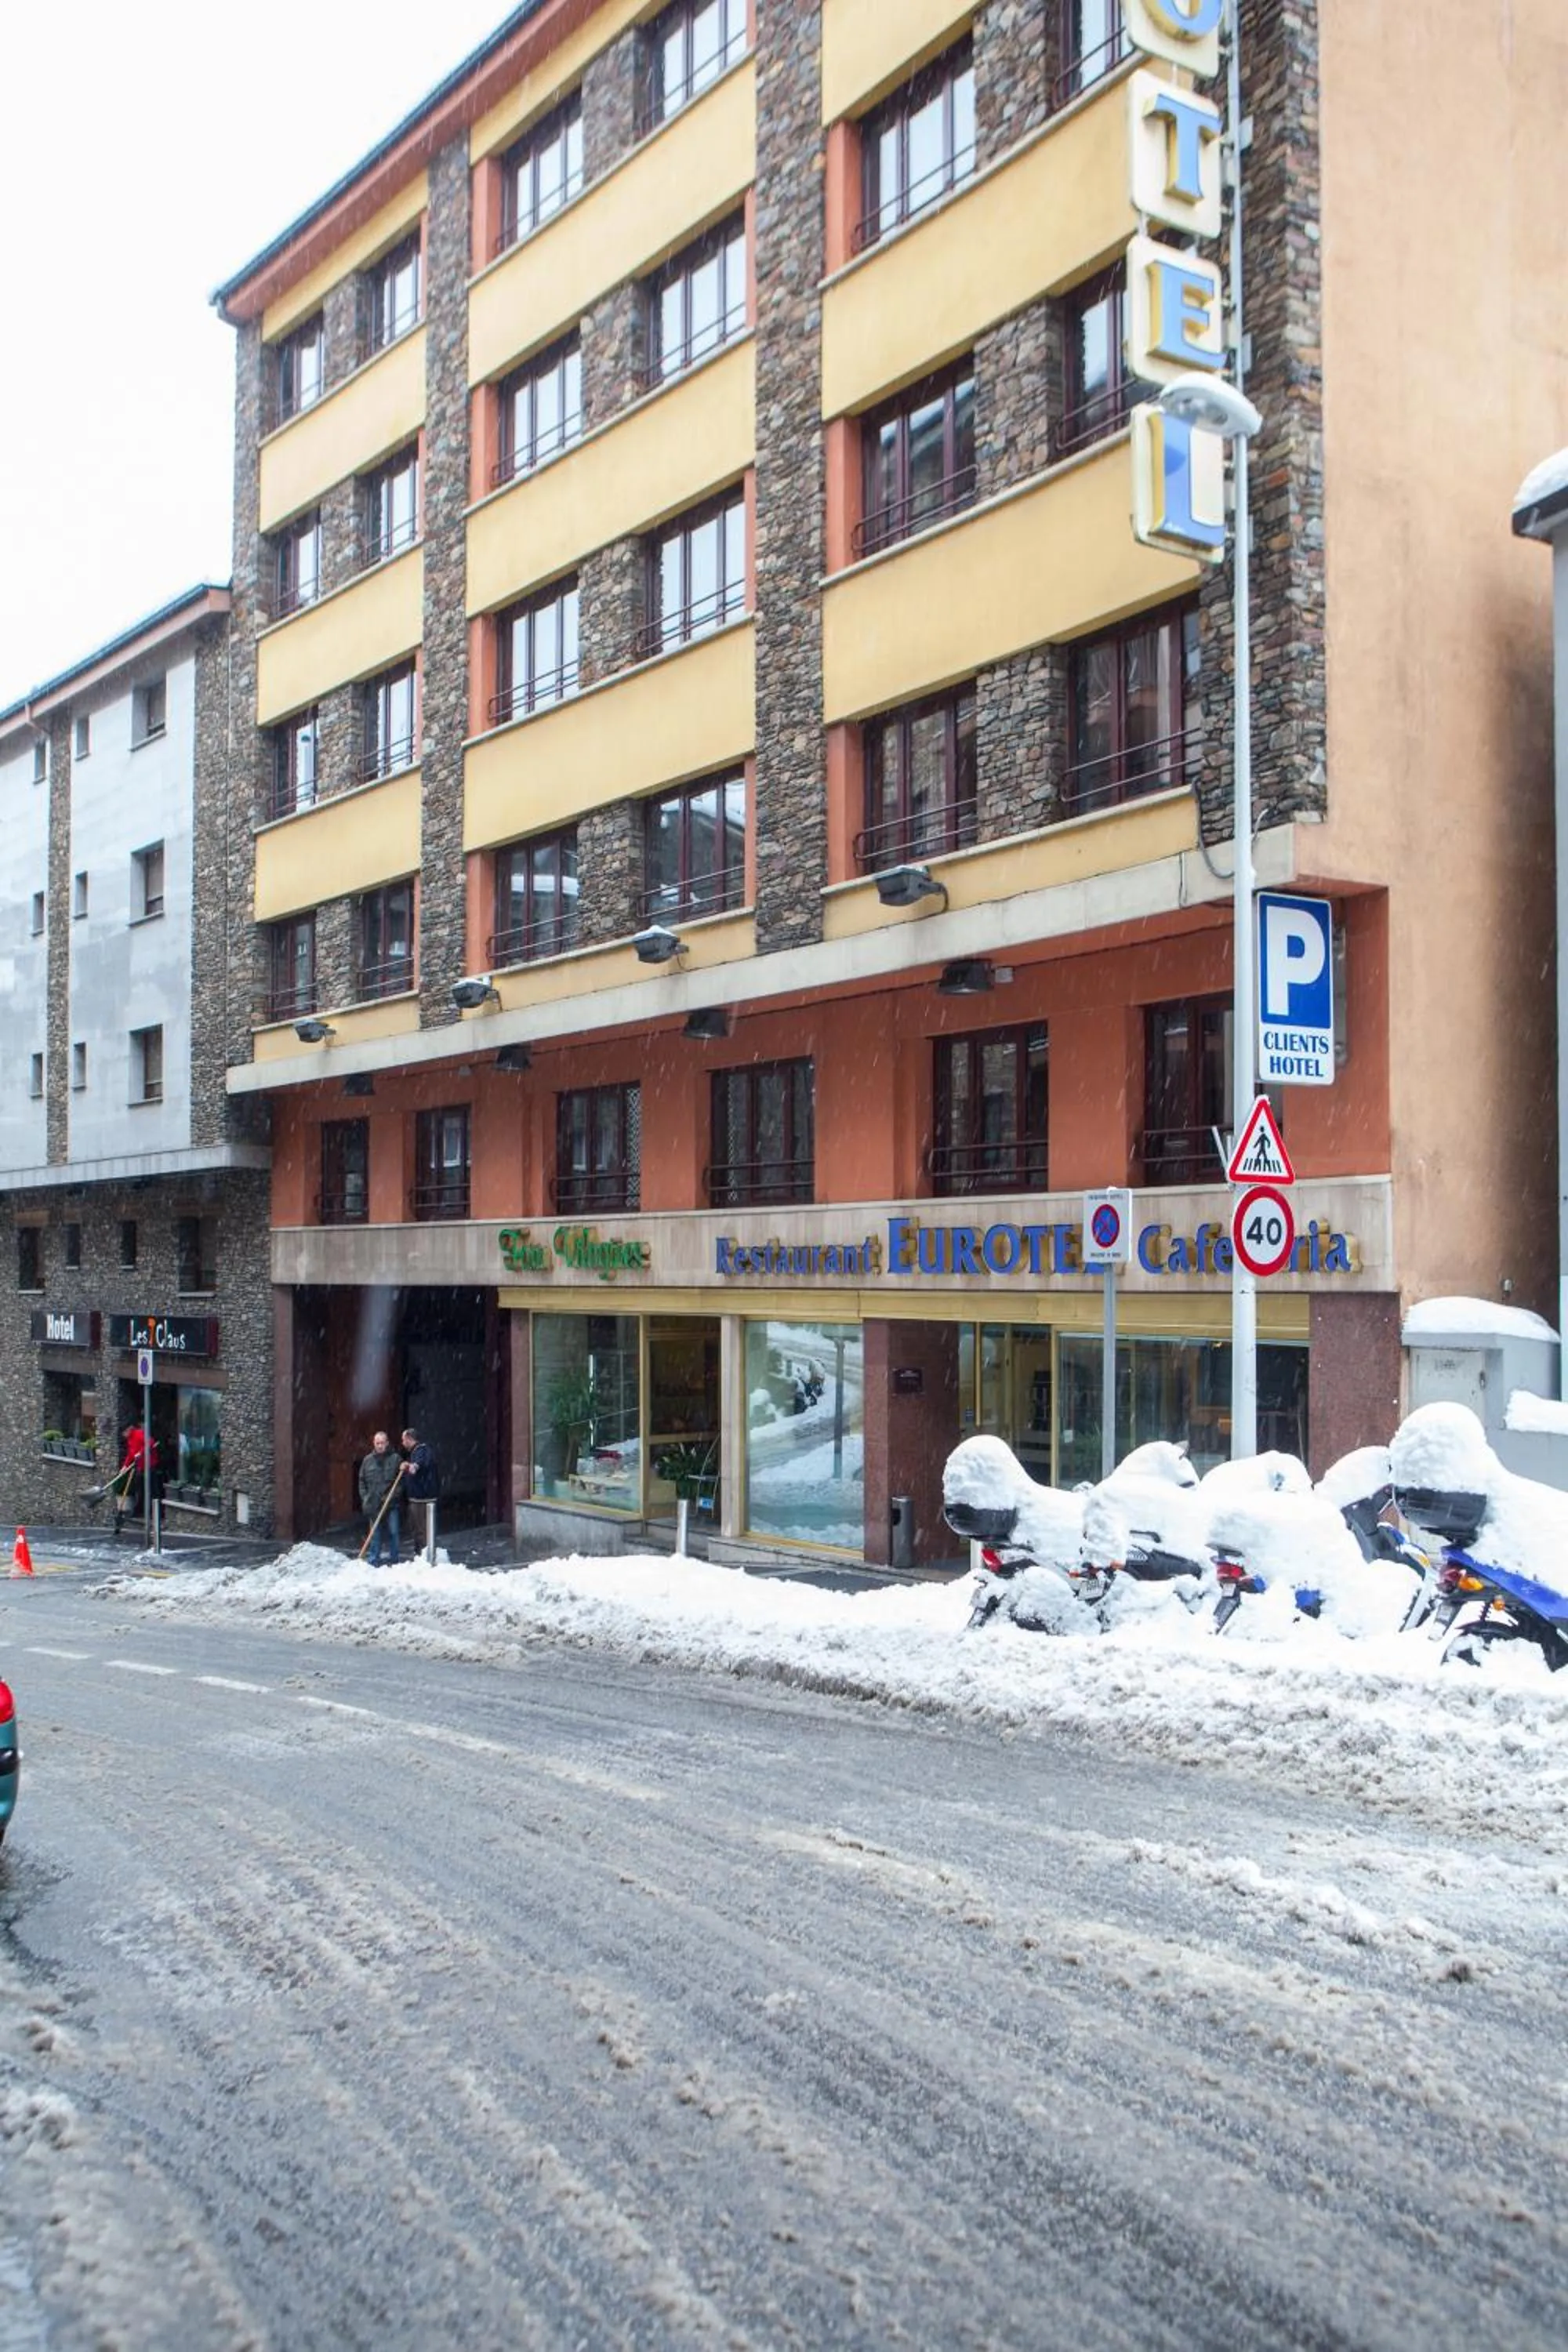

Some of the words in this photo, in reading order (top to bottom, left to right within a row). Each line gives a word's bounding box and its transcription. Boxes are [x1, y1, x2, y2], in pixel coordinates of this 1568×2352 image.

[1266, 905, 1326, 1016] P
[1263, 1031, 1329, 1054] CLIENTS
[1269, 1055, 1324, 1077] HOTEL
[1246, 1216, 1282, 1246] 40
[716, 1236, 873, 1274] Restaurant
[887, 1218, 1107, 1275] EUROTE
[1138, 1219, 1352, 1274] Caferia
[46, 1313, 74, 1341] Hotel
[130, 1319, 148, 1347] Les
[155, 1319, 186, 1349] Claus
